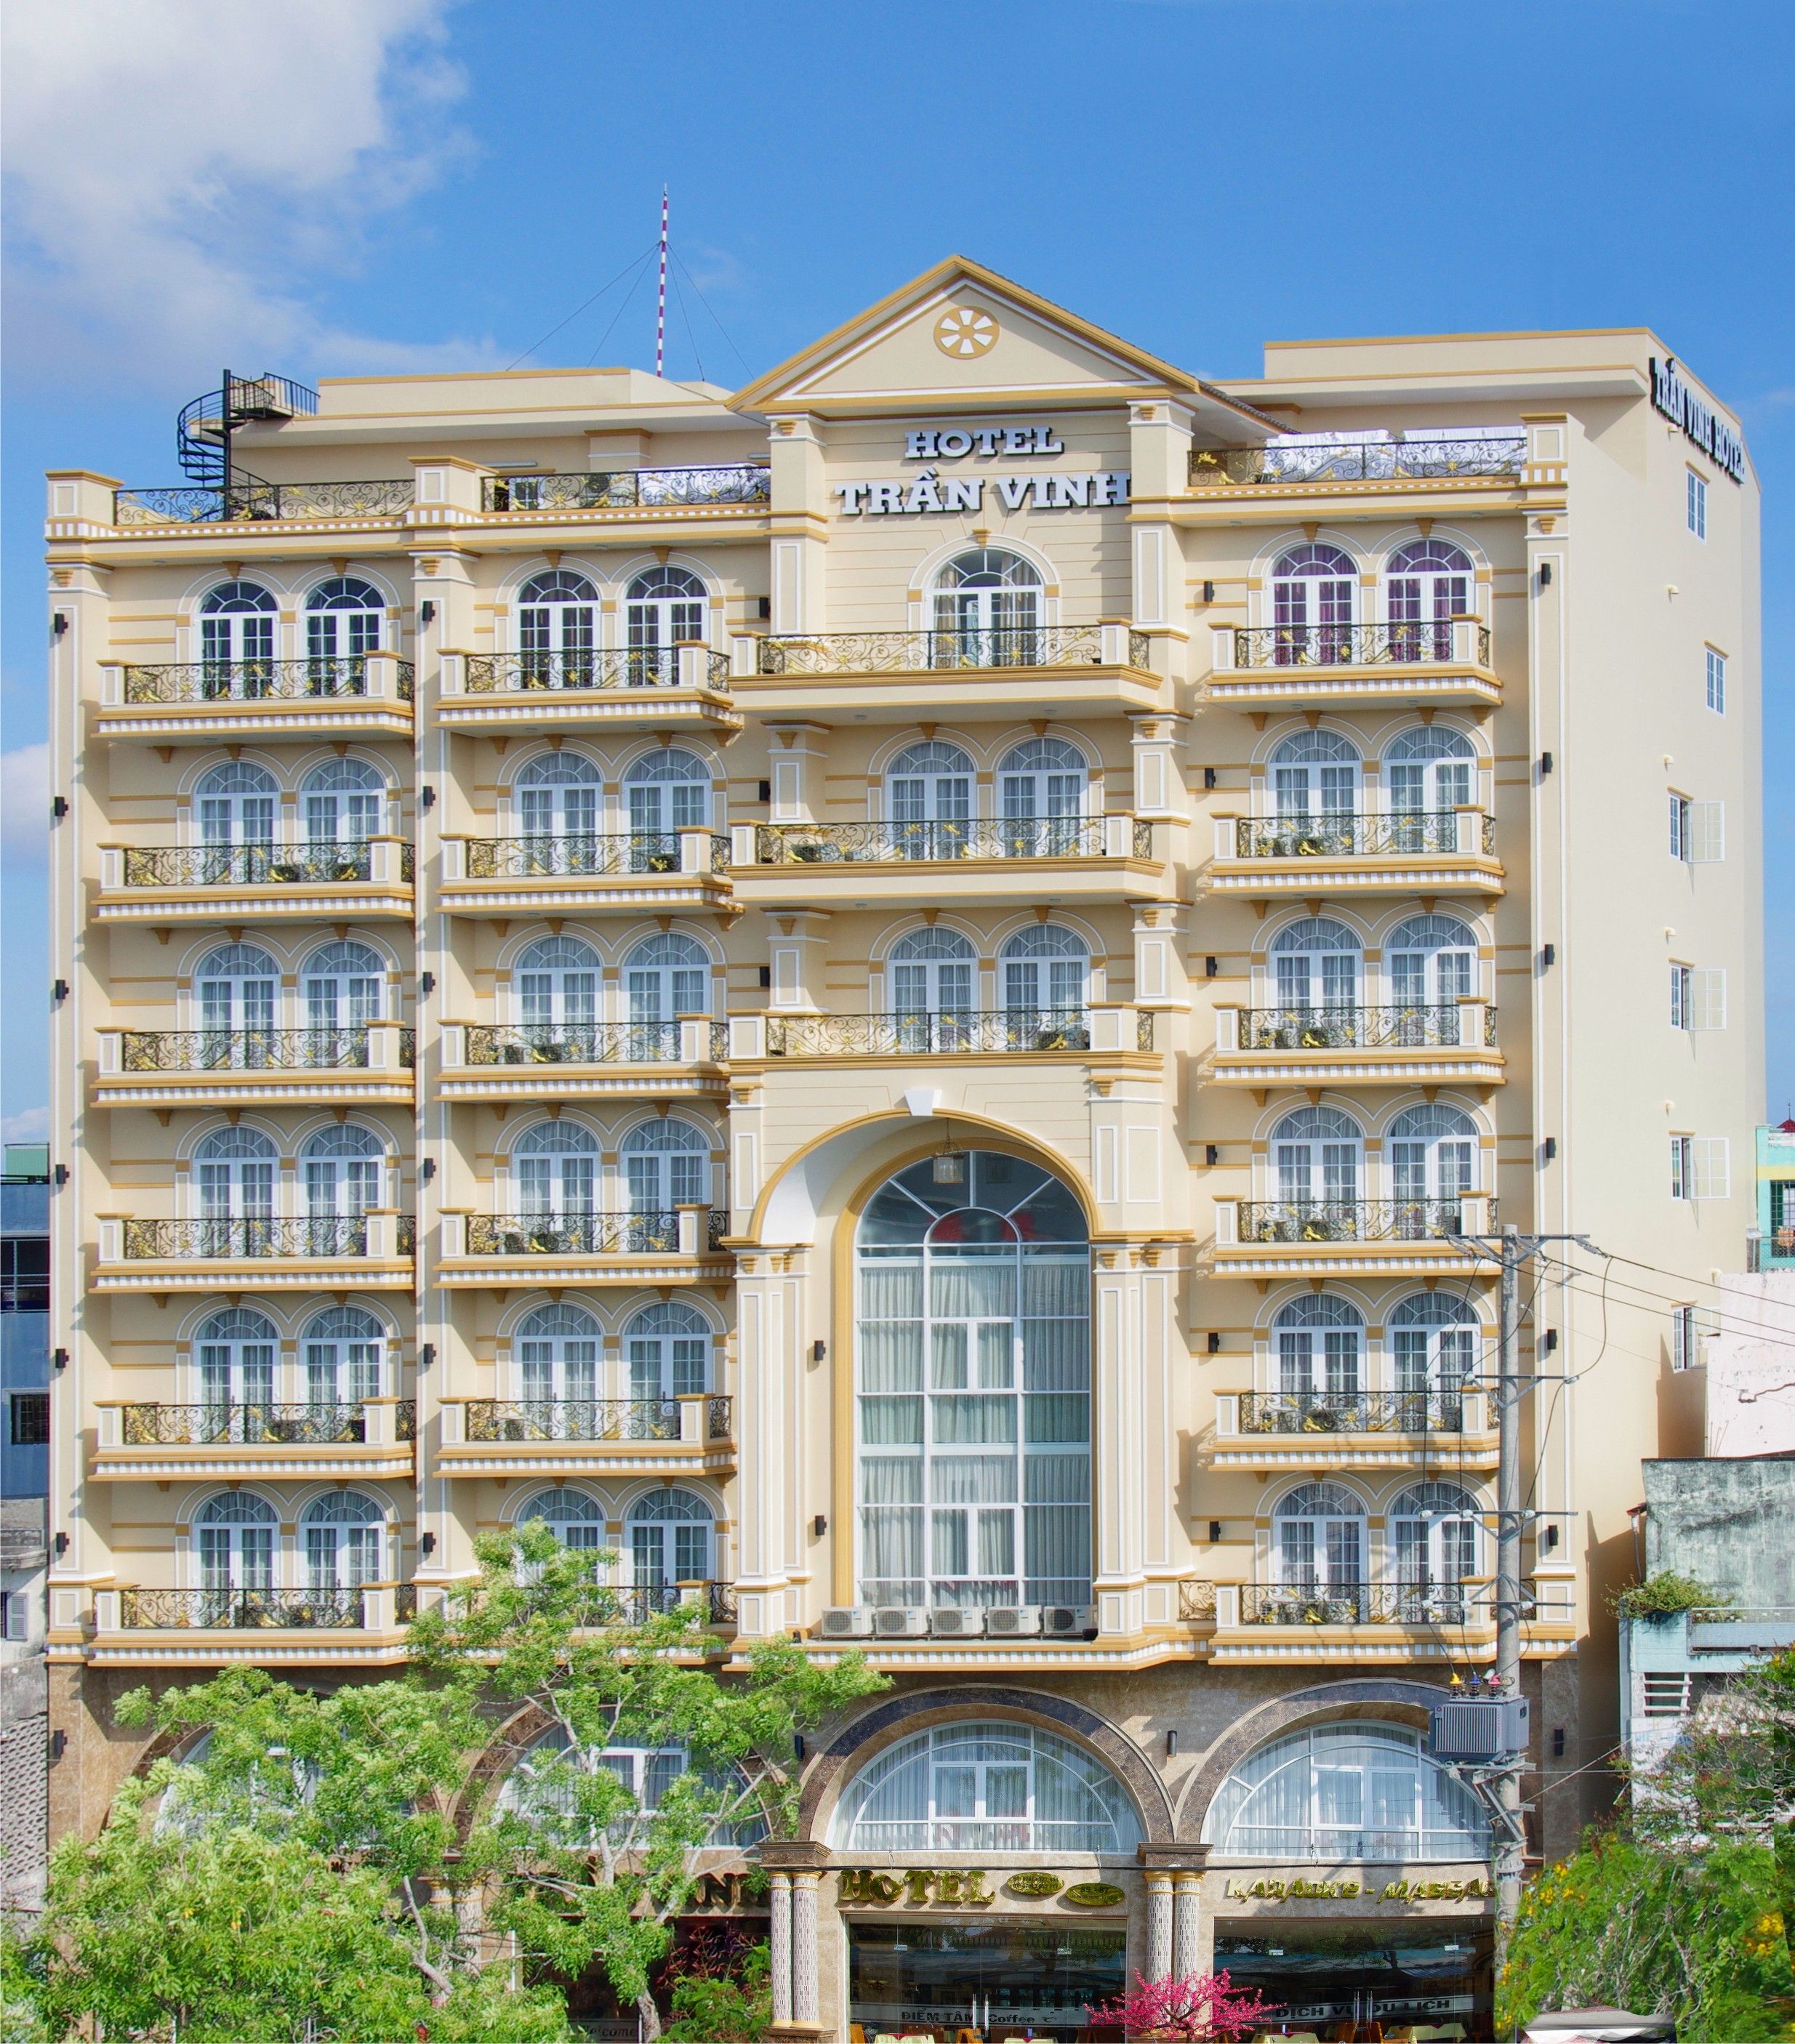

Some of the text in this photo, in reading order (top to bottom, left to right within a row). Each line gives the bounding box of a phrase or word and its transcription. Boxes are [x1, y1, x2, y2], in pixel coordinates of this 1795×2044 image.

[905, 427, 1064, 459] HOTEL
[1711, 415, 1745, 485] HOTEL
[835, 466, 1131, 515] TRẦN VINH
[840, 1870, 996, 1903] HOTEL
[901, 2008, 939, 2021] ĐIỂM
[988, 2013, 1035, 2024] Coffee
[1276, 2006, 1324, 2019] DỊCH
